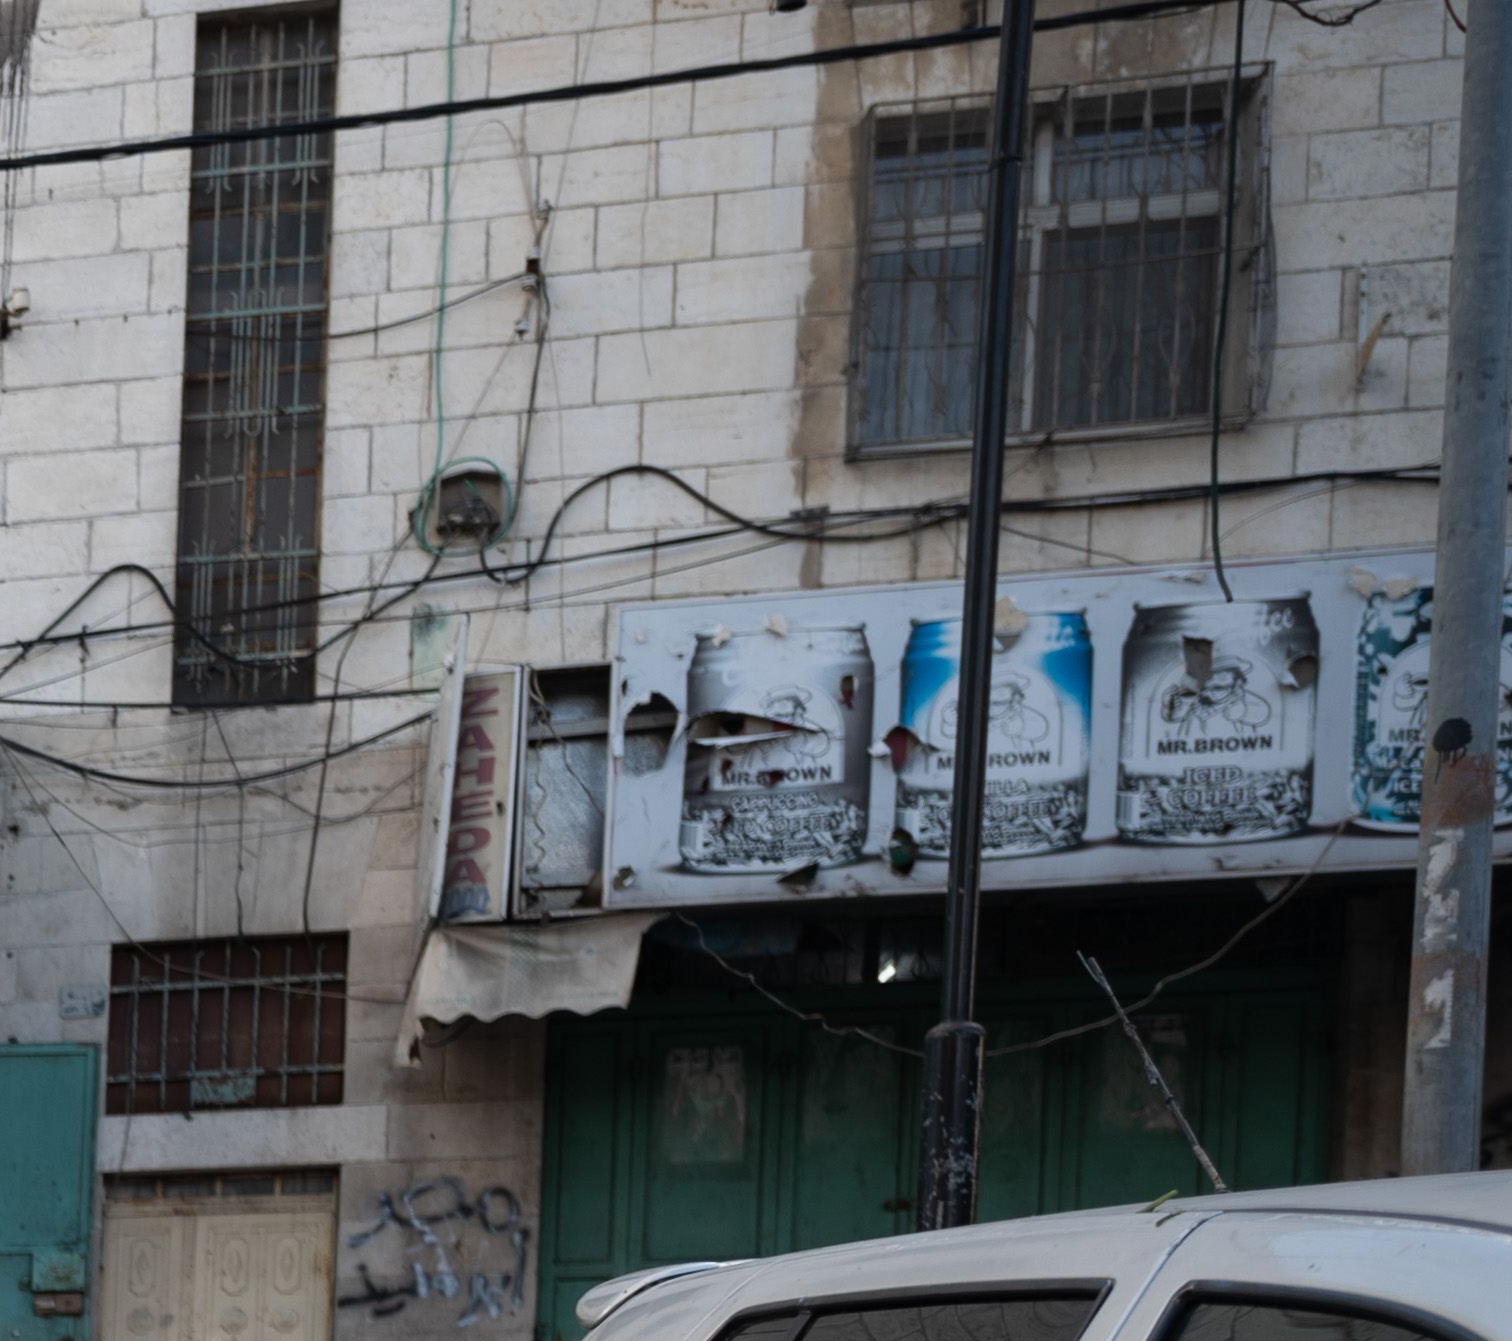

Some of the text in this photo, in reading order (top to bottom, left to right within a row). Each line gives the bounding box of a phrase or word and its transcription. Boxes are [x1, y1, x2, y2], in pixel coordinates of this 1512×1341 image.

[1157, 736, 1273, 756] MR.BROWN
[1184, 766, 1243, 784] ICED
[1167, 788, 1256, 806] COFFEE
